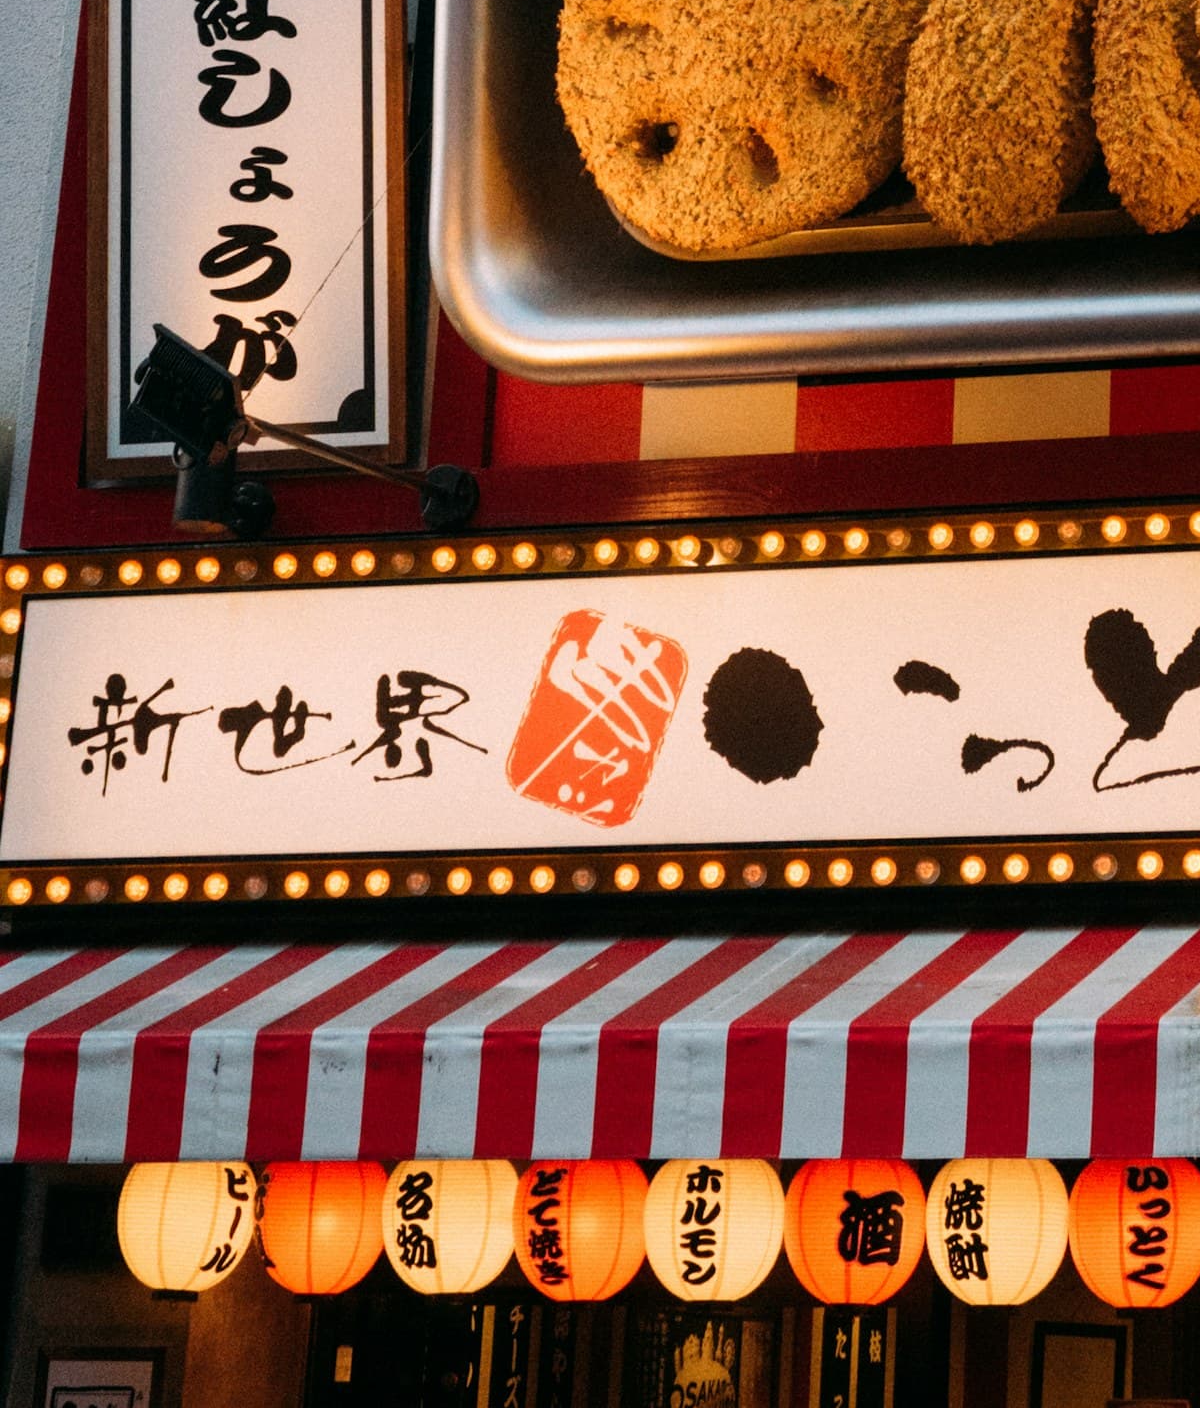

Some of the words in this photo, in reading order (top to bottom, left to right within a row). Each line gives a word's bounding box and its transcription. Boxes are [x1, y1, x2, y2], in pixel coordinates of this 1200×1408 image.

[68, 671, 487, 795] 新世界
[201, 1166, 252, 1272] ビール
[396, 1173, 437, 1269] 名物
[526, 1169, 570, 1285] どて焼き
[680, 1165, 724, 1285] ホルモン
[838, 1189, 905, 1267] 酒
[944, 1179, 989, 1281] 焼酎
[1126, 1166, 1172, 1289] いっとく
